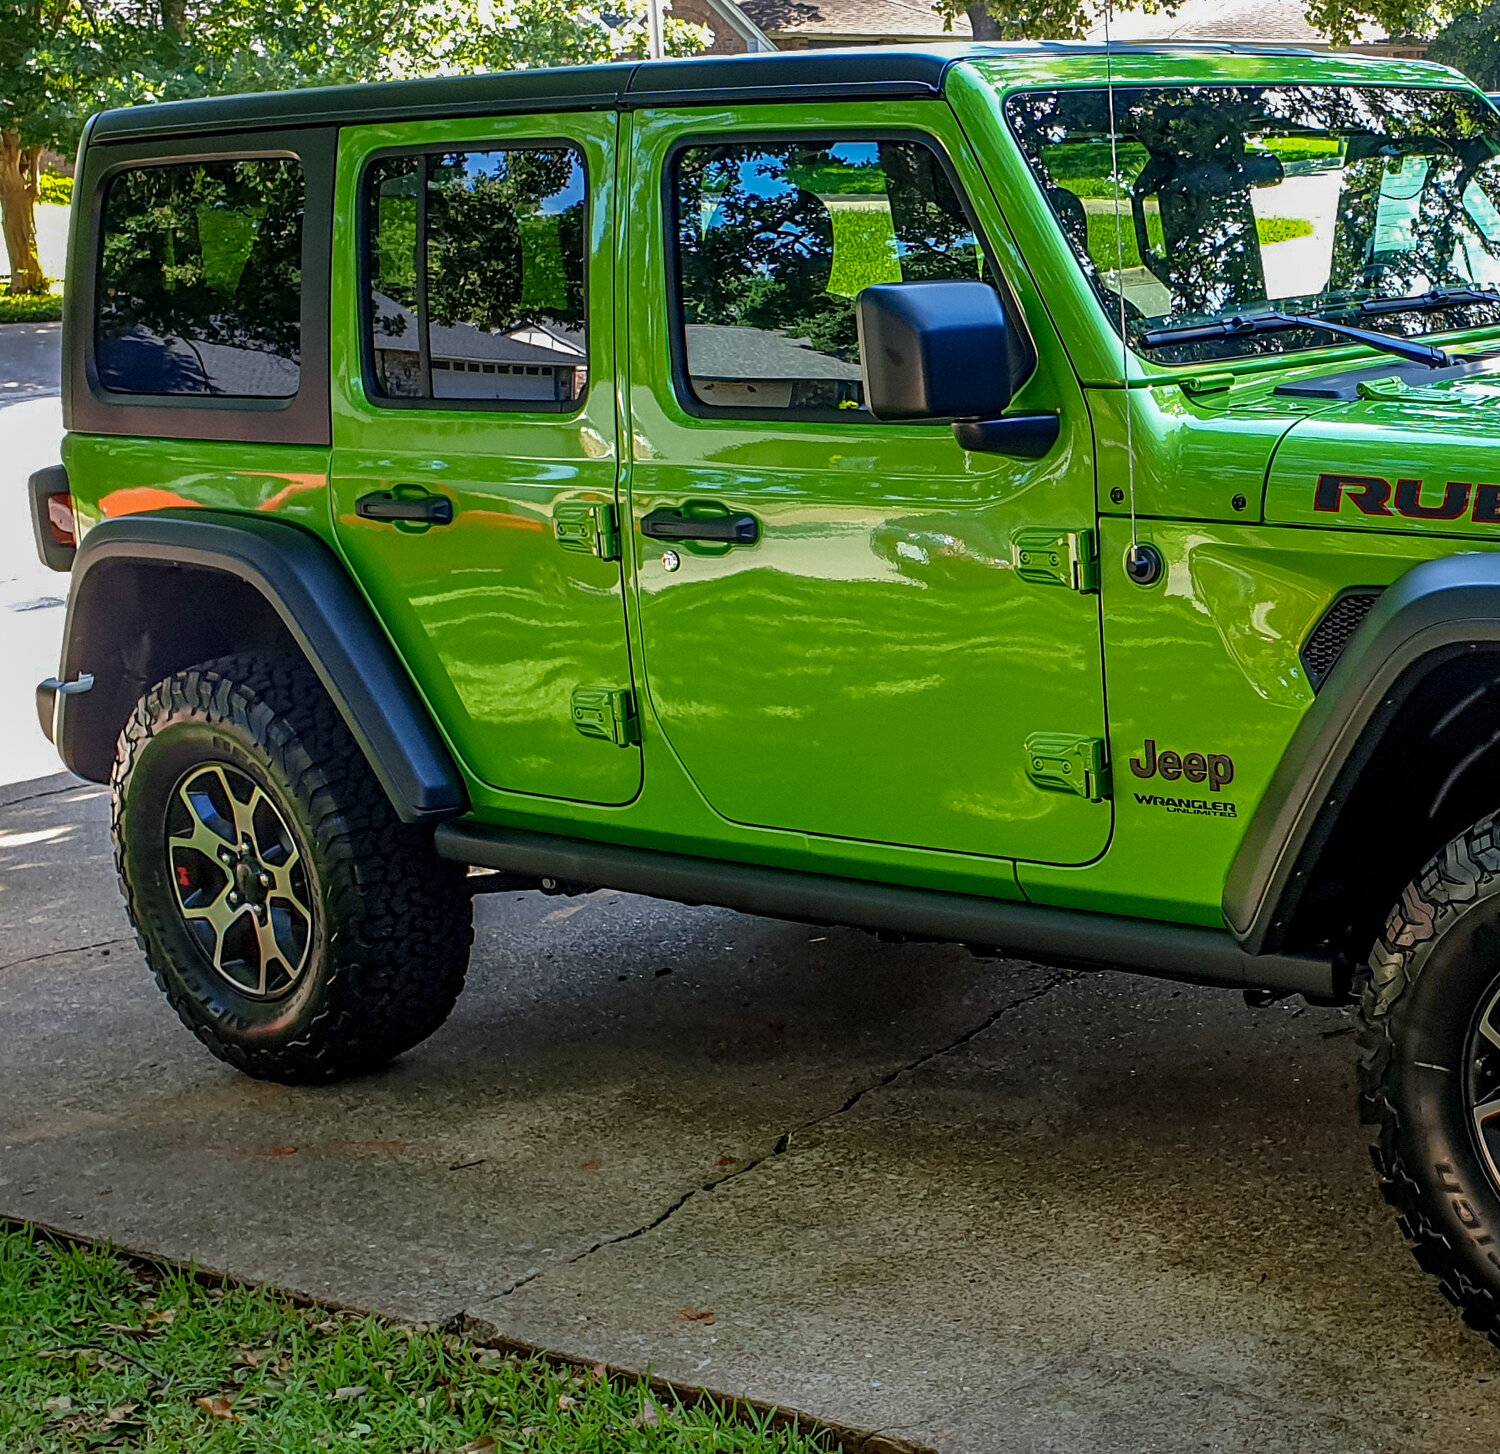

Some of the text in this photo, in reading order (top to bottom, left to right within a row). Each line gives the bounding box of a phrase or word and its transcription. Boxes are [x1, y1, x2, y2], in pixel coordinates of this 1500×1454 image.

[1129, 739, 1234, 792] Jeep
[1134, 793, 1236, 813] WRANGLER
[1166, 807, 1238, 818] UNLIMITED
